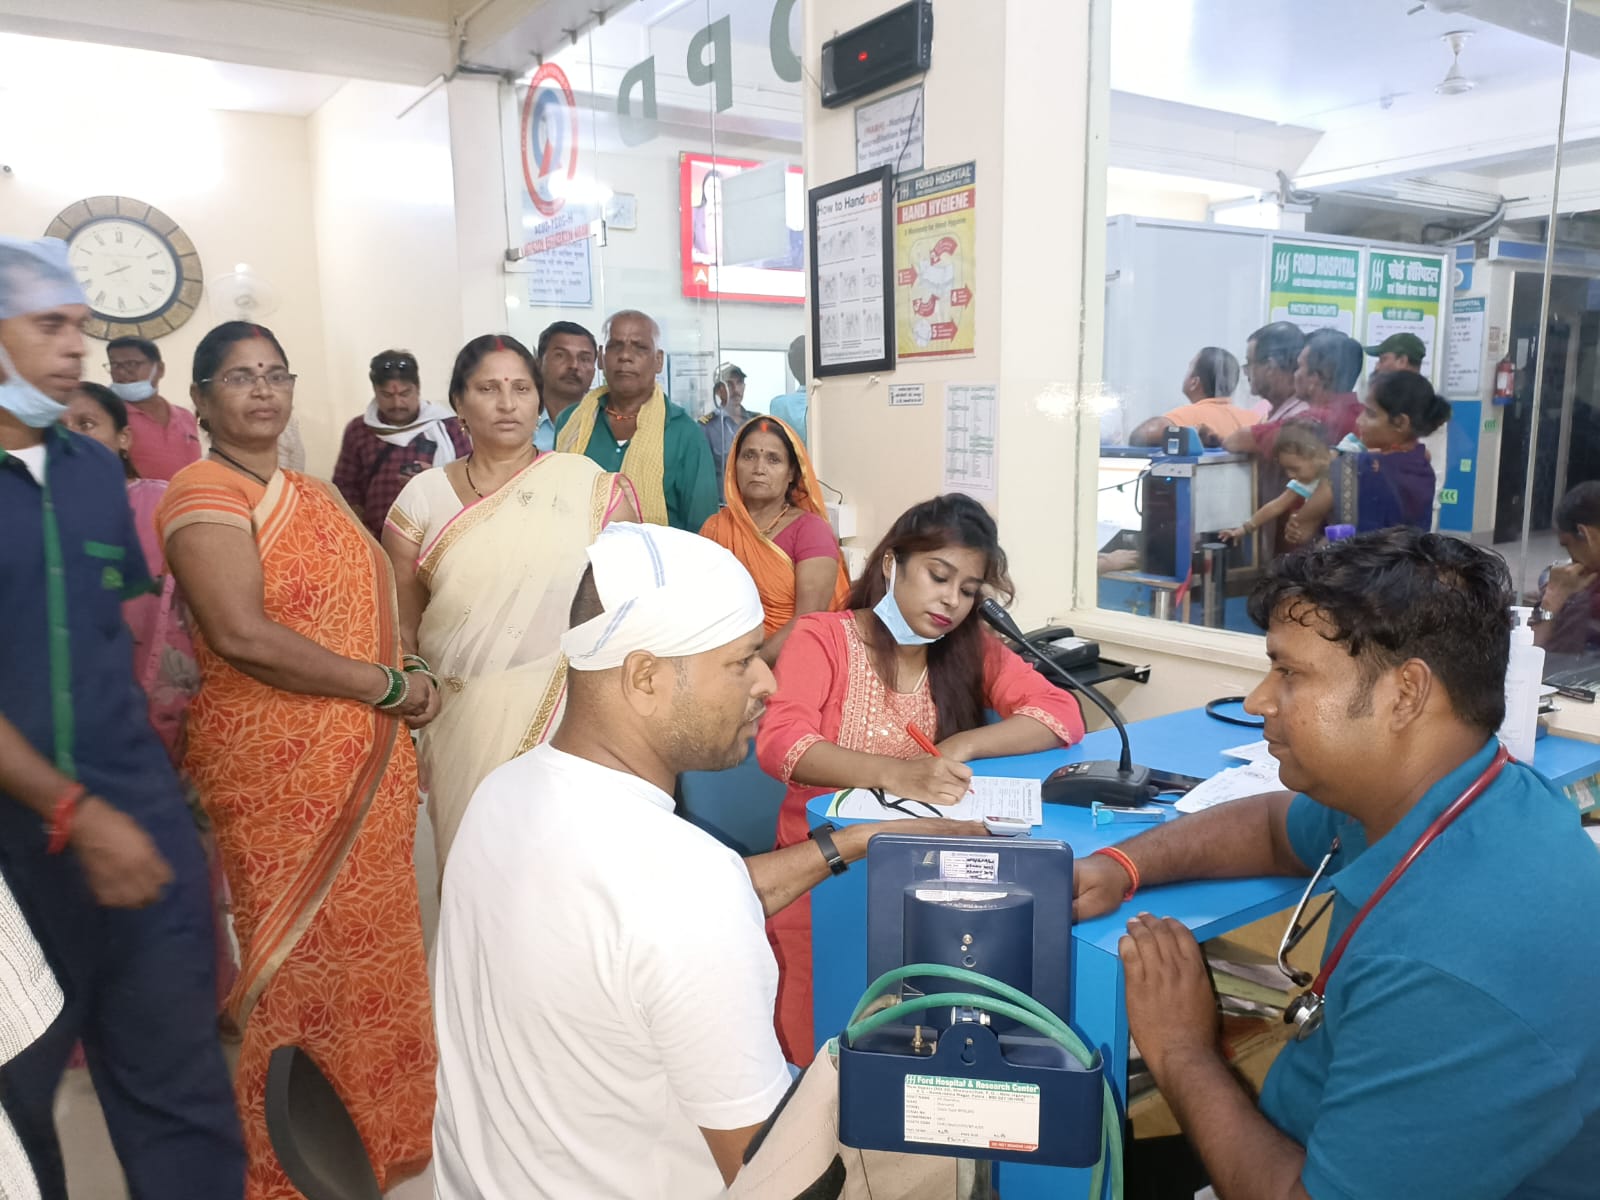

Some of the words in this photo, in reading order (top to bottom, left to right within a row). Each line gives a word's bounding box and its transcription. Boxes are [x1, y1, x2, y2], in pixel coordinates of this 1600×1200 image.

[935, 166, 972, 185] HOSPITAL
[834, 201, 843, 211] to
[902, 202, 927, 223] HAND
[928, 192, 969, 216] HYGIENE
[1292, 253, 1316, 275] FORD
[1316, 255, 1356, 278] HOSPITAL
[917, 1075, 934, 1085] Ford
[935, 1077, 966, 1088] Hospital
[967, 1080, 974, 1089] &
[975, 1081, 1011, 1091] Research
[1012, 1083, 1039, 1093] Center
